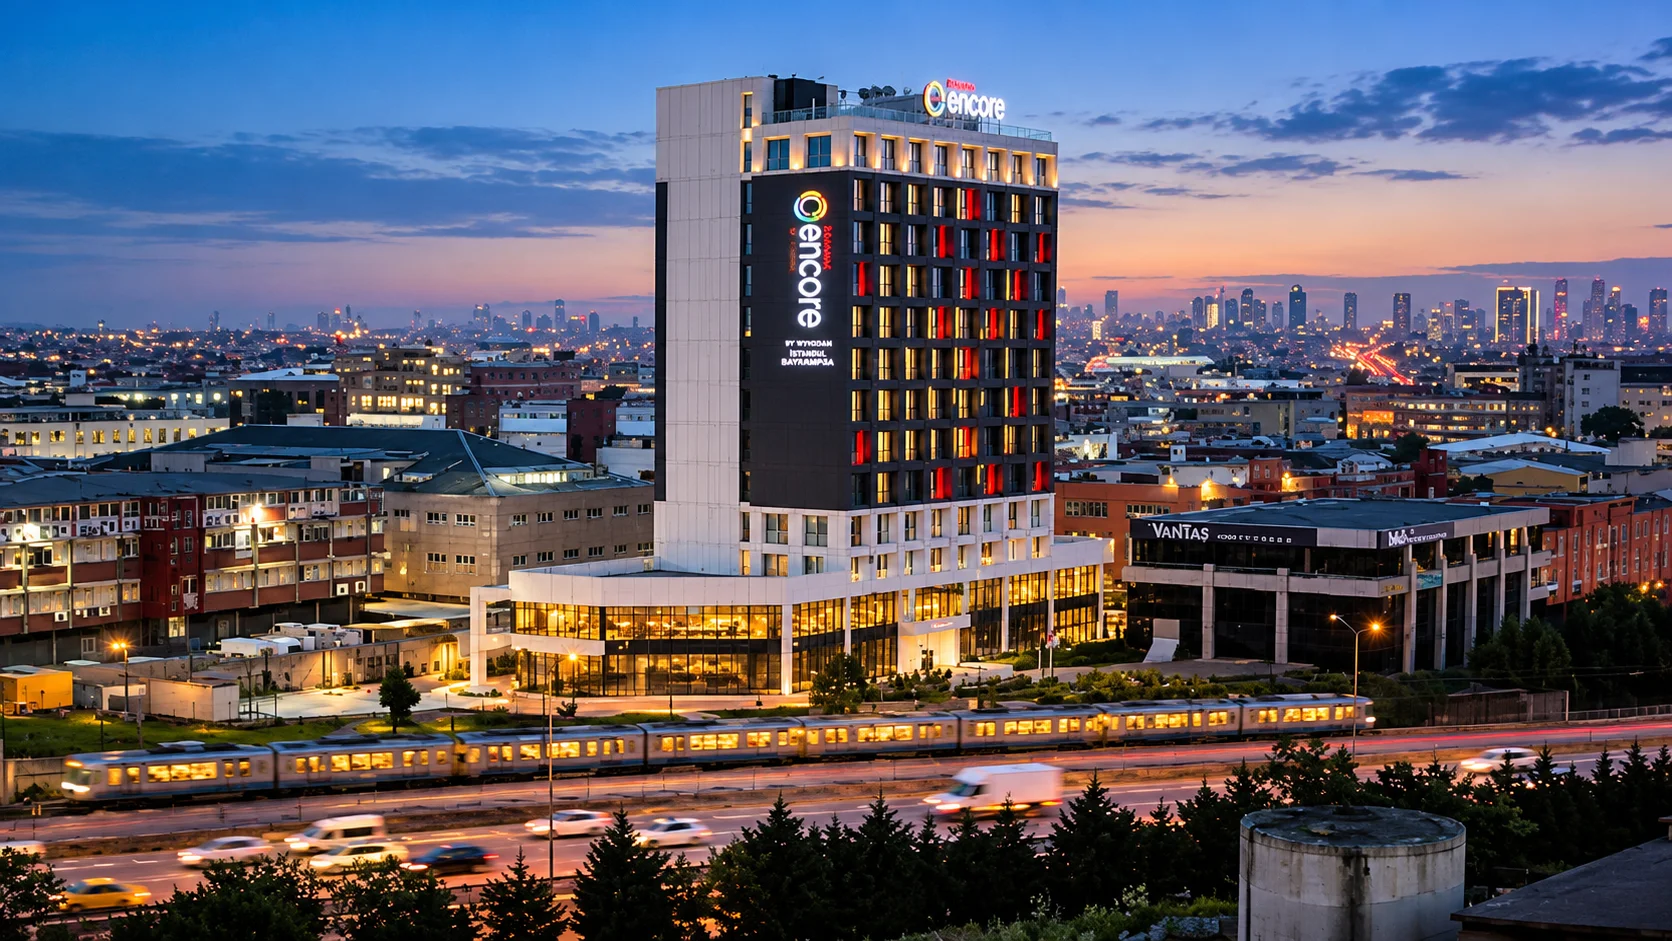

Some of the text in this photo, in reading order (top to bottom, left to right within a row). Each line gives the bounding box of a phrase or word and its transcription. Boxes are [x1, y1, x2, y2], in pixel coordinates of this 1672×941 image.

[946, 90, 1006, 120] encore
[797, 224, 822, 328] encore
[1152, 522, 1210, 543] VANTAŞ
